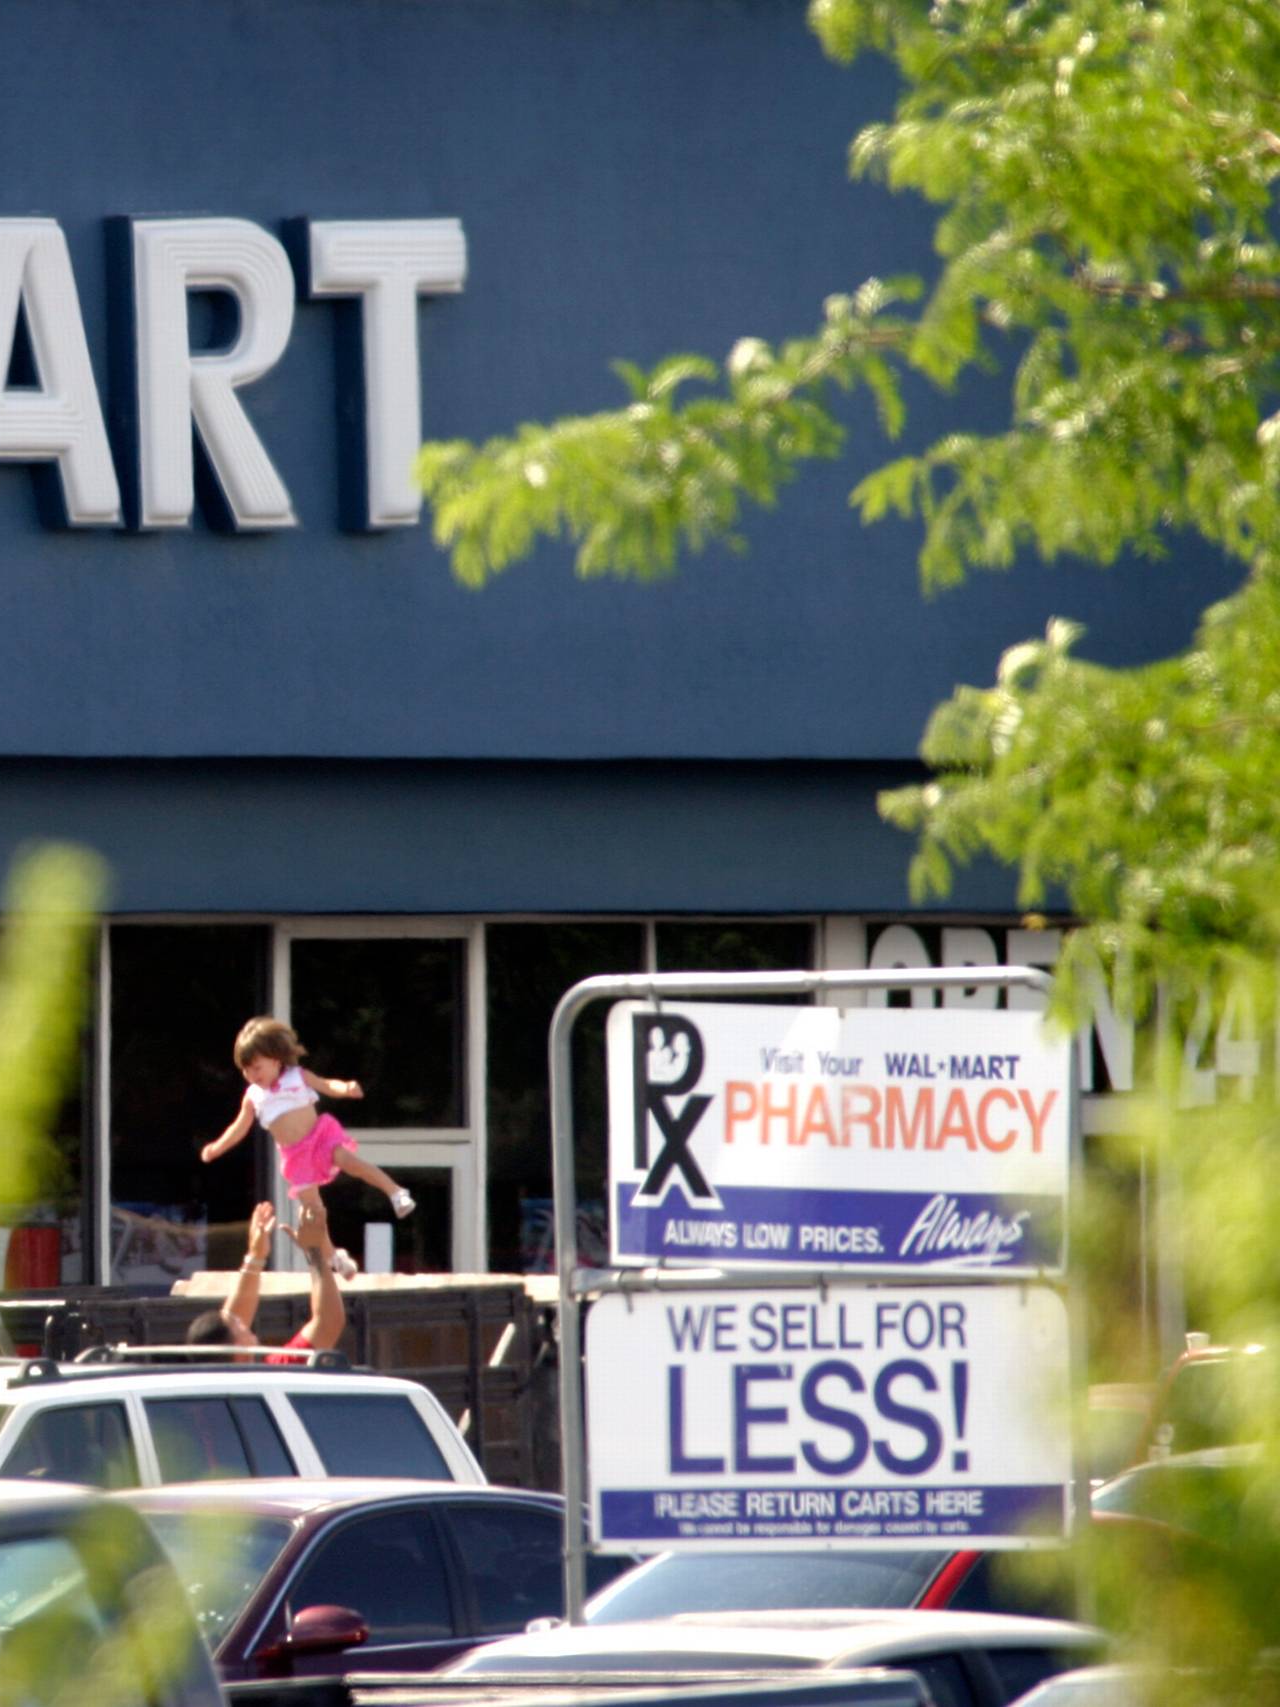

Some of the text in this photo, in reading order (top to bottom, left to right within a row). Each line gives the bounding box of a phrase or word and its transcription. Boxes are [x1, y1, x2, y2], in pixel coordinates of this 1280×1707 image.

[759, 1048, 805, 1074] Visit
[818, 1050, 863, 1077] Your
[724, 1080, 1060, 1154] PHARMACY
[664, 1218, 886, 1254] ALWAYS LOW PRICES.
[667, 1299, 968, 1352] WE SELL FOR
[668, 1358, 970, 1476] LESS!
[654, 1489, 985, 1519] PLEASE RETURN CARTS HERE
